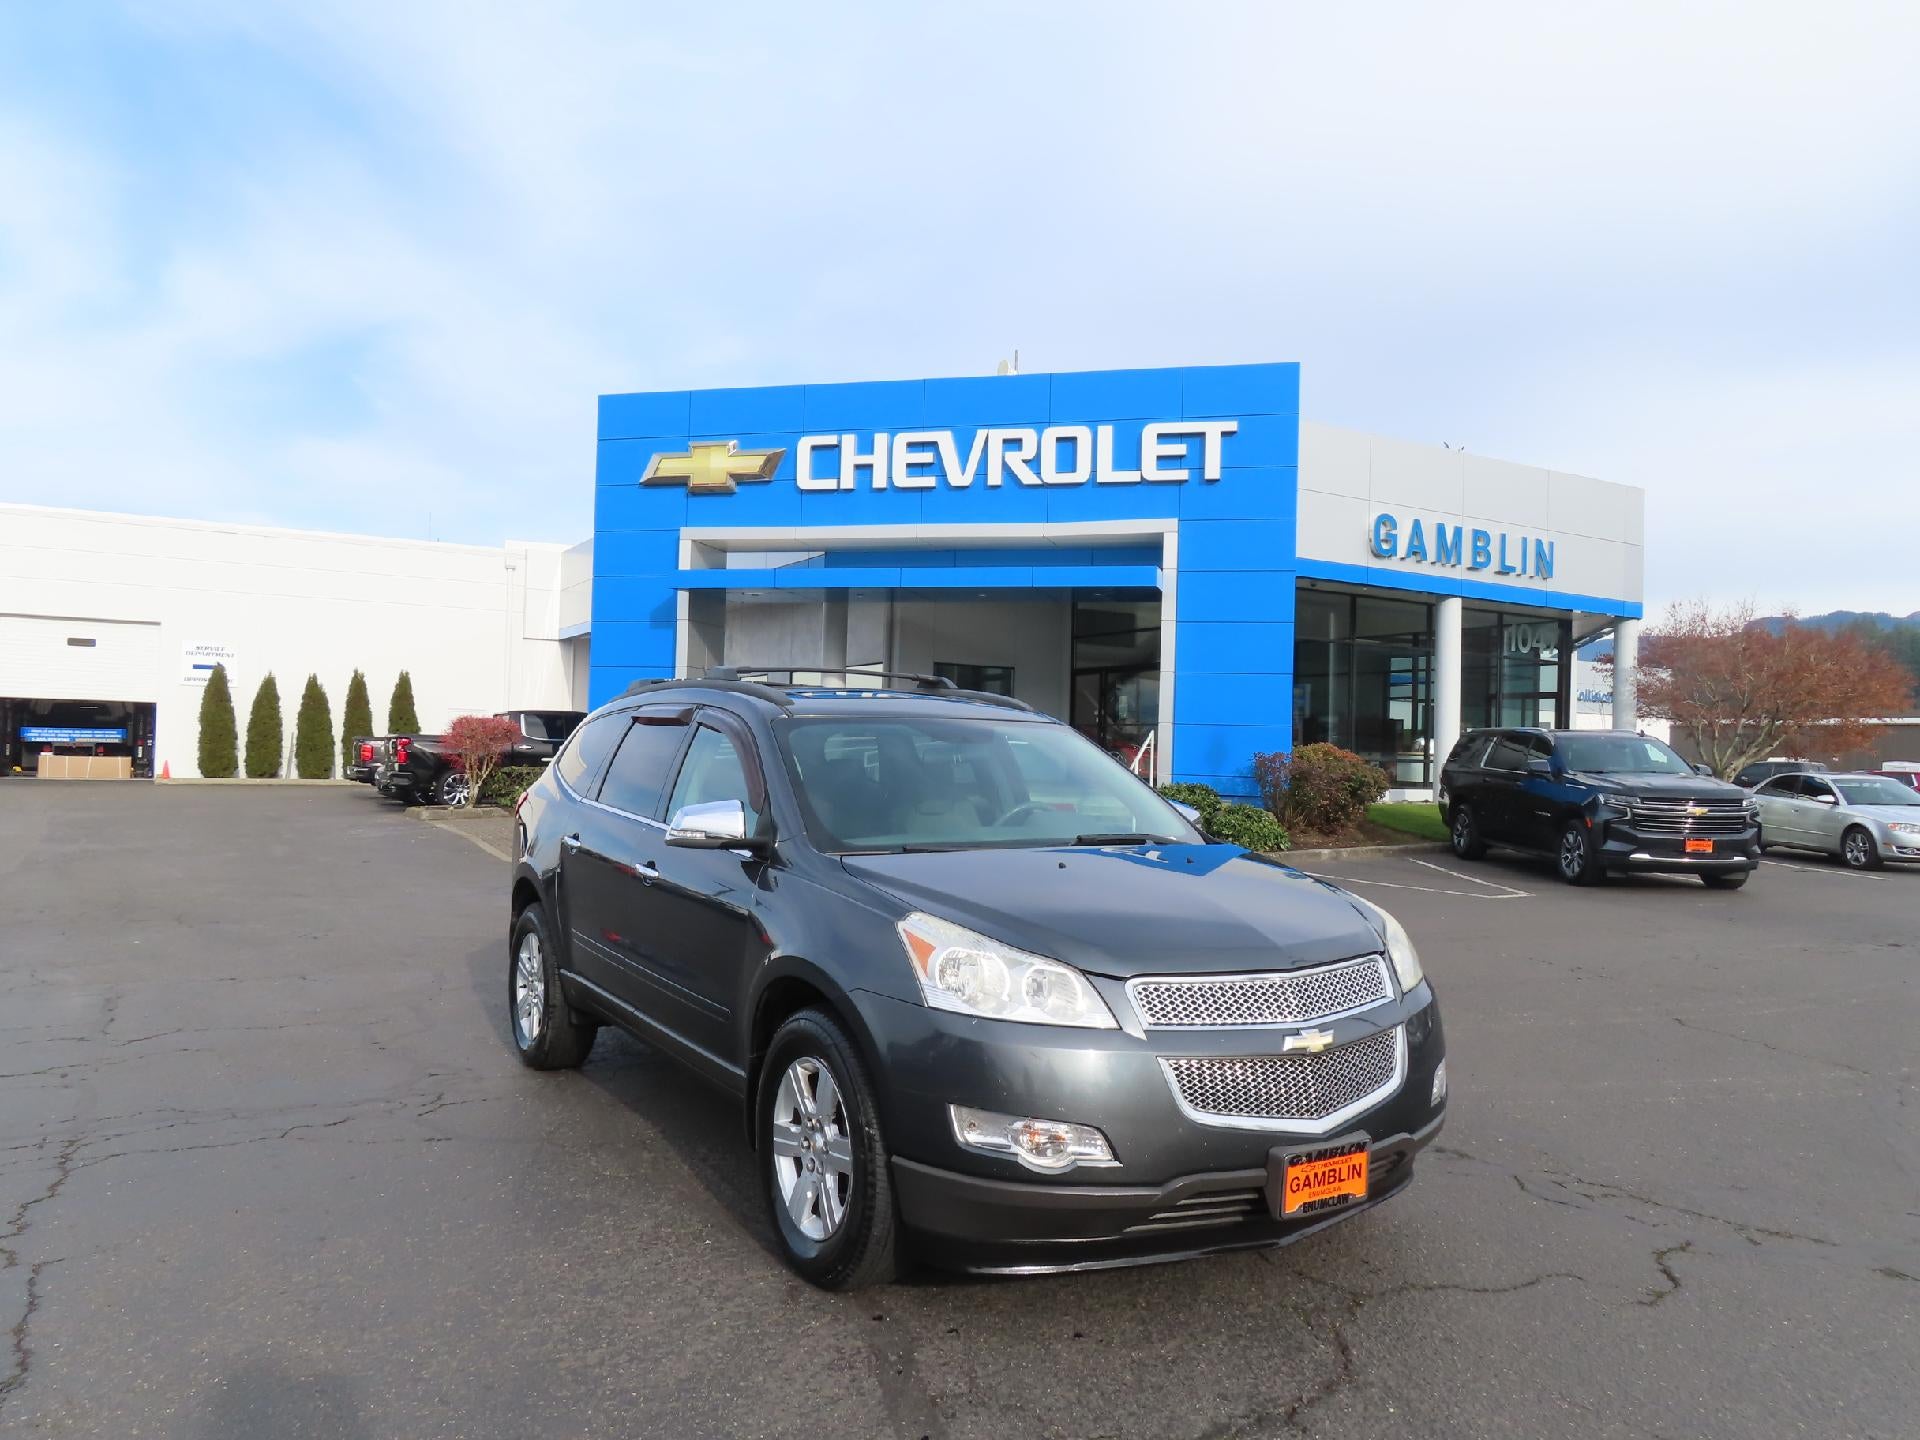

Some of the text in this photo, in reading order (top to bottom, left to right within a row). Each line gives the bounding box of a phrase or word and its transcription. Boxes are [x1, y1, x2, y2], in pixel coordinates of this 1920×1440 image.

[795, 420, 1239, 491] CHEVROLET
[1370, 512, 1555, 580] GAMBLIN
[1290, 1162, 1363, 1194] GAMBLIN
[1302, 1193, 1350, 1213] ENUMCLAW
